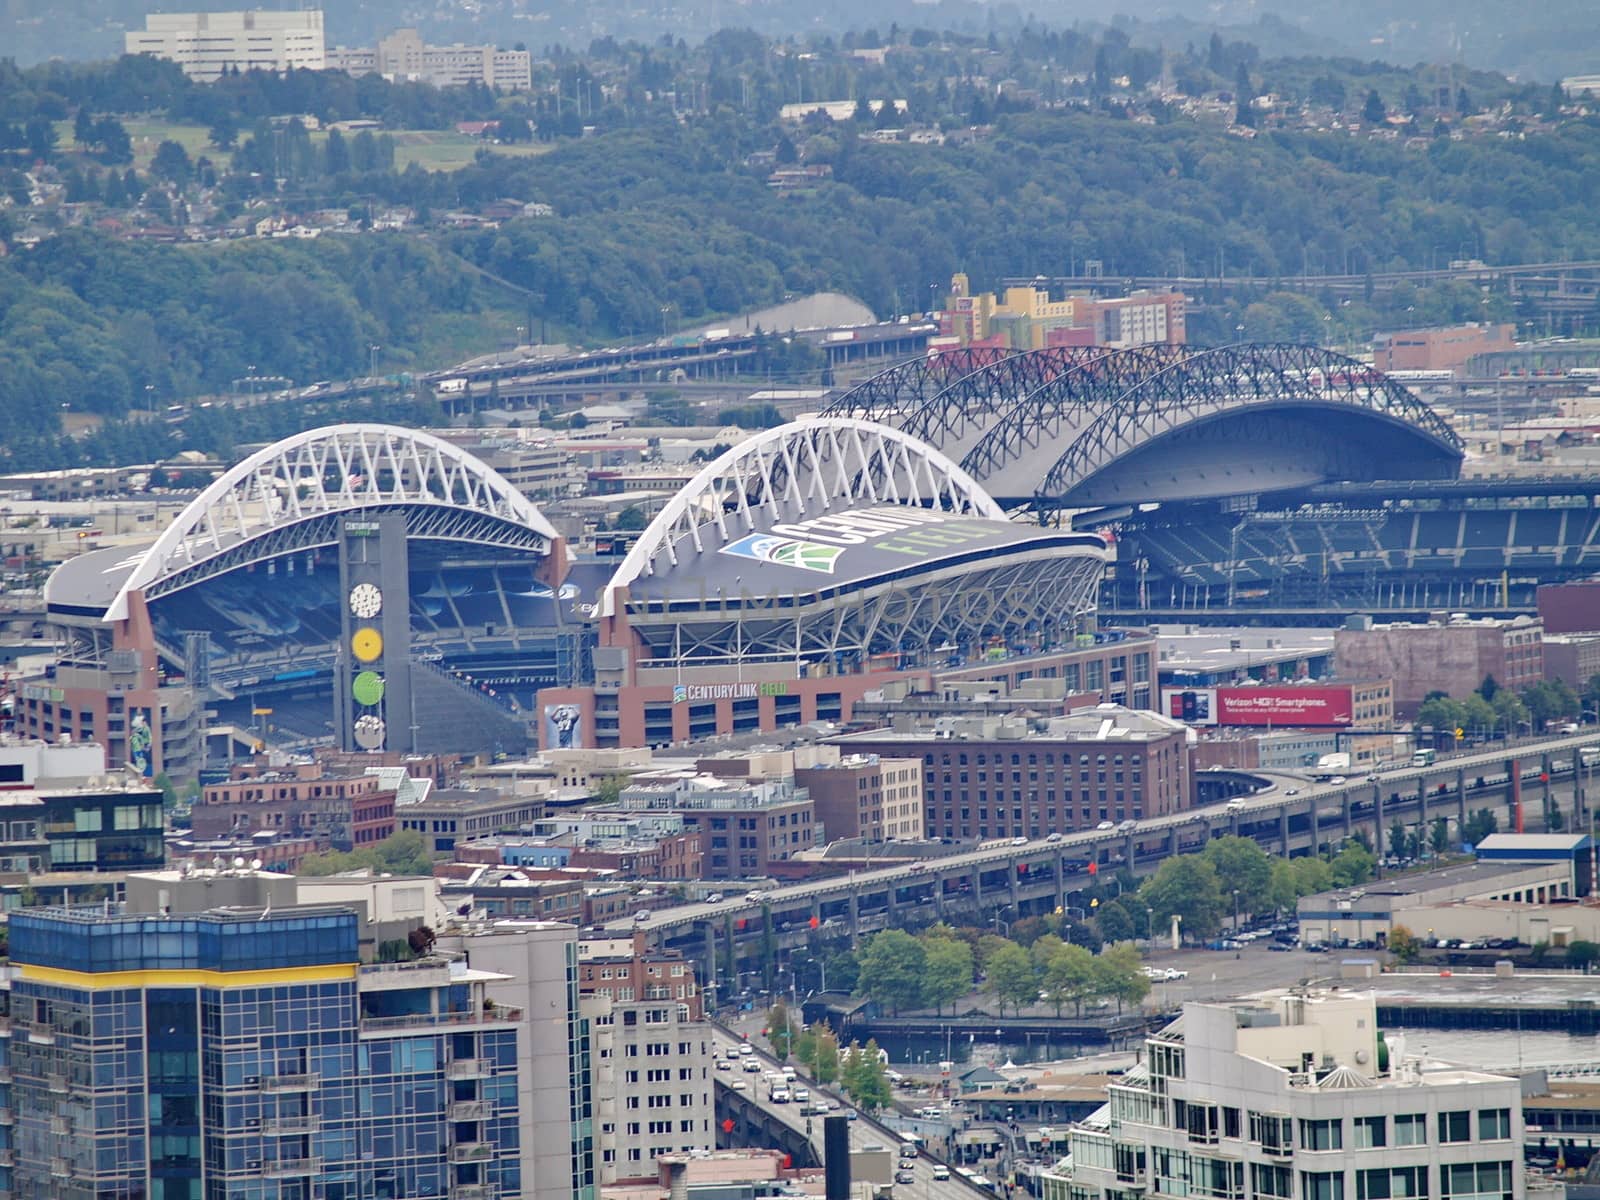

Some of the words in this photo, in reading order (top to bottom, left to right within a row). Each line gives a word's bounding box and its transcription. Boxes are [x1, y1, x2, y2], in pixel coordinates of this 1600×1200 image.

[873, 524, 1004, 556] FIELD
[687, 683, 758, 700] CENTURYLINK
[760, 682, 786, 697] FIELD
[1224, 697, 1253, 706] Verizon
